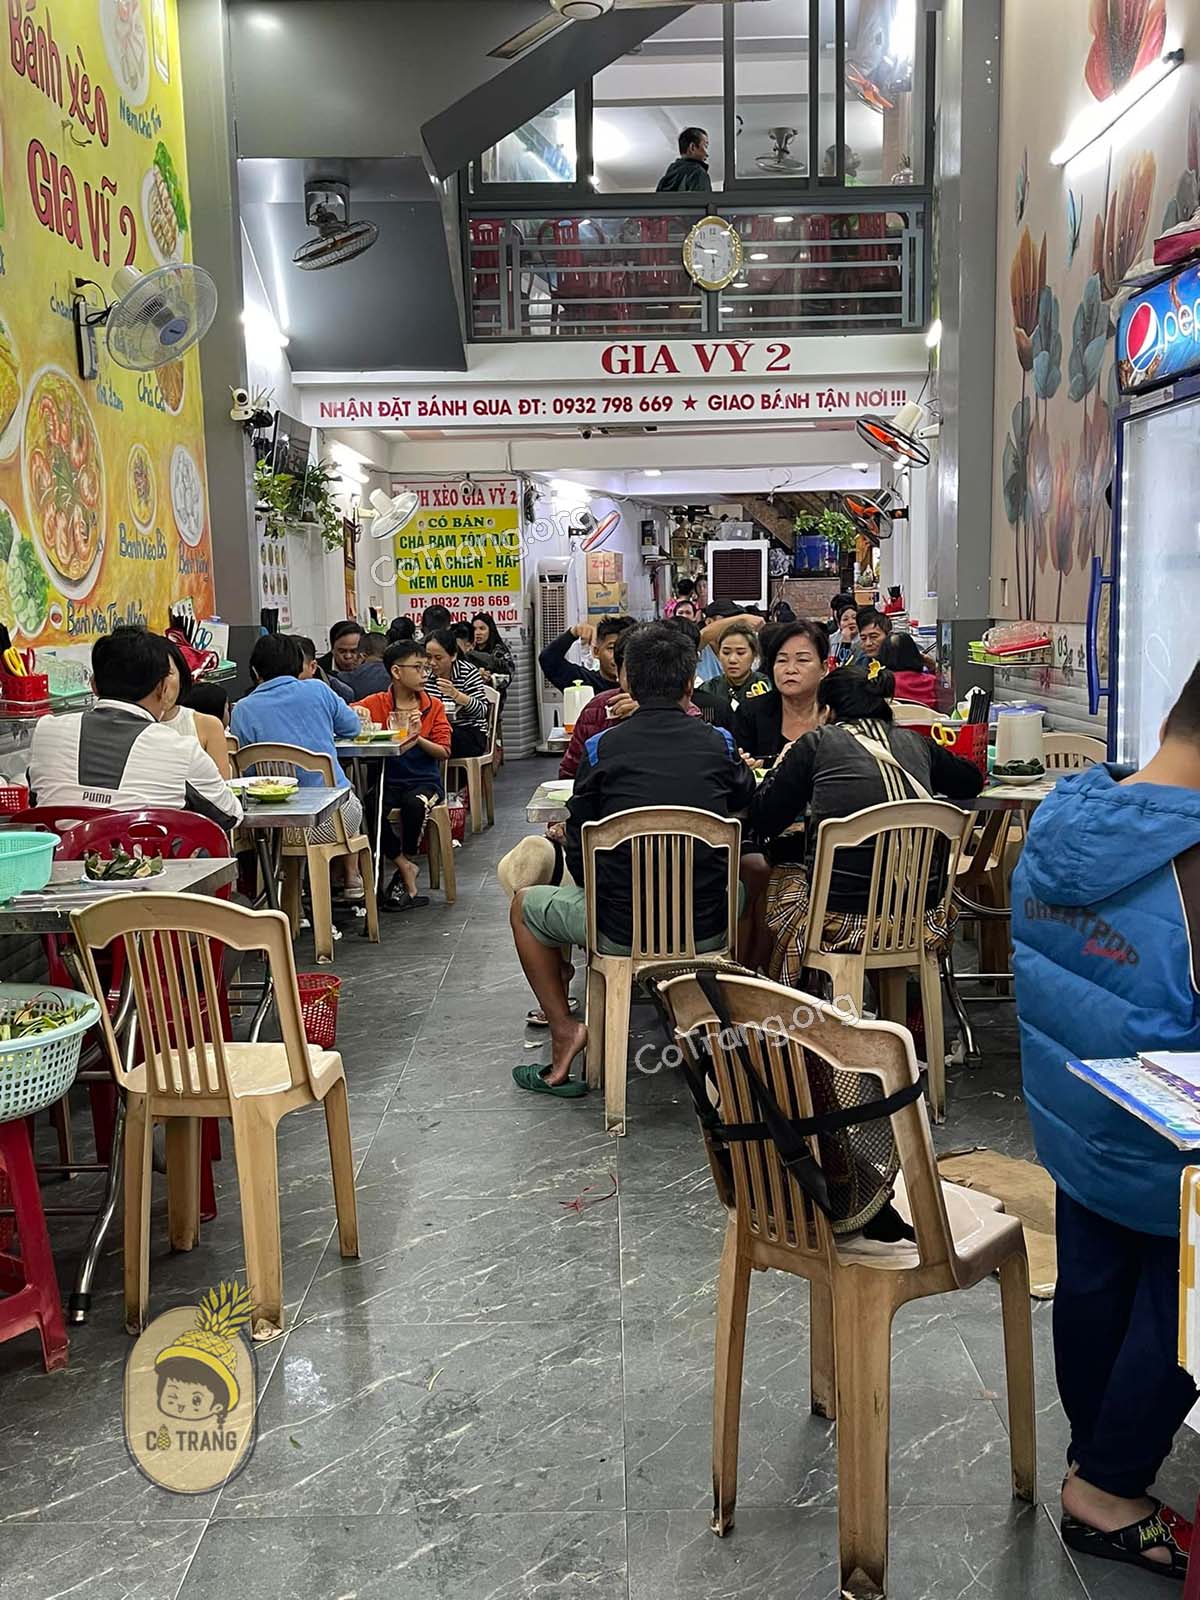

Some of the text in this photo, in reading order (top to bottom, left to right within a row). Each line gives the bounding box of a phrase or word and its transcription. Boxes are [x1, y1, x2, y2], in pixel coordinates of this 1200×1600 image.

[601, 339, 791, 375] GIA VỸ 2
[320, 397, 373, 421] NHẬN
[378, 396, 411, 421] ĐẶT
[418, 395, 467, 417] BÁNH
[473, 399, 512, 416] QUA
[518, 398, 547, 416] ĐT:
[553, 398, 597, 415] 0932
[602, 397, 633, 413] 798
[639, 396, 673, 412] 669
[707, 393, 754, 411] GIAO
[761, 389, 810, 410] BÁNH
[815, 388, 851, 412] TẬN
[433, 484, 458, 506] XÈO
[488, 483, 507, 505] VỸ
[510, 490, 518, 504] 2
[428, 514, 484, 528] CÓ BÁN
[400, 531, 424, 549] CHẢ
[409, 576, 437, 589] NEM
[442, 574, 474, 588] CHUA
[410, 595, 510, 608] ĐT: 0932 798 669
[498, 608, 518, 621] NƠI
[82, 791, 112, 805] PUMA
